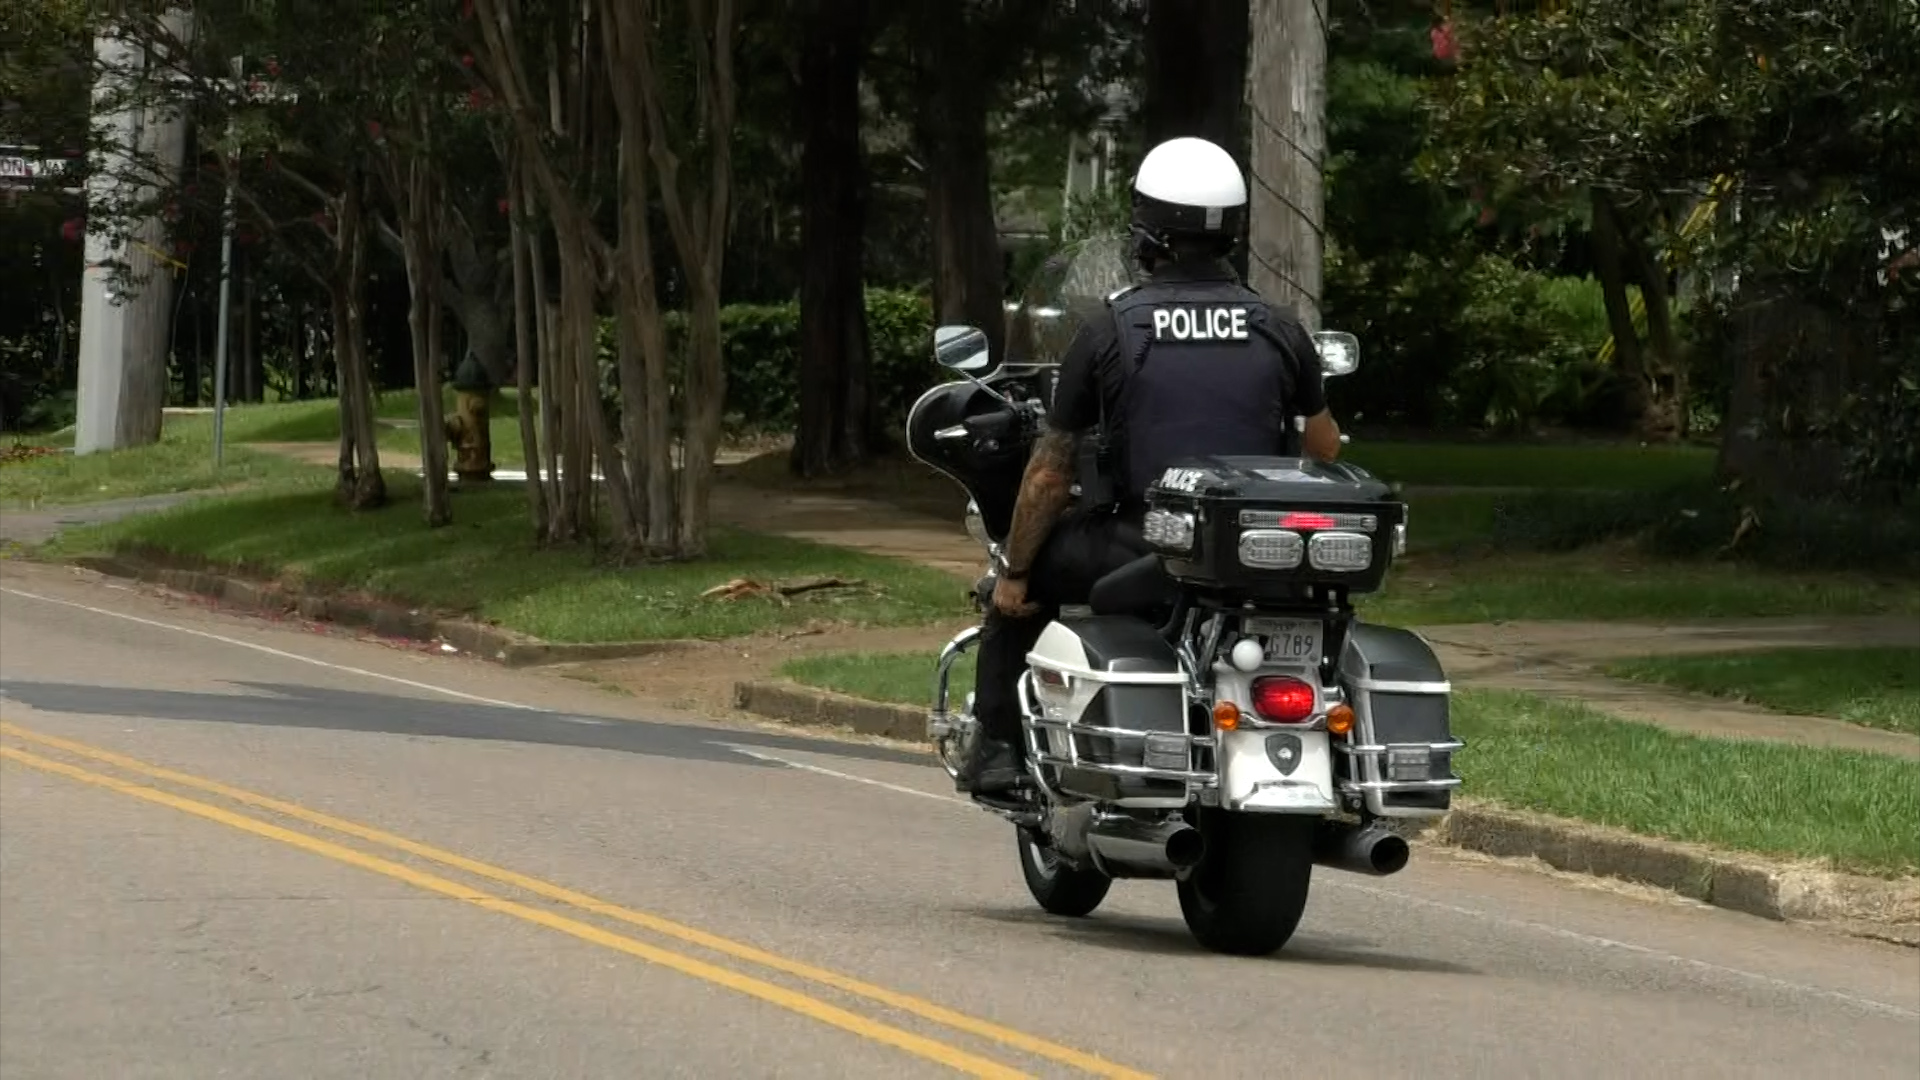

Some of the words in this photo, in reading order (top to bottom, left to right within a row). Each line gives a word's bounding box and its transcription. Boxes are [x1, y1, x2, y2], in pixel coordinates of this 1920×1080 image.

[1153, 307, 1249, 339] POLICE
[1159, 467, 1203, 492] POLICE
[1262, 632, 1314, 656] G789
